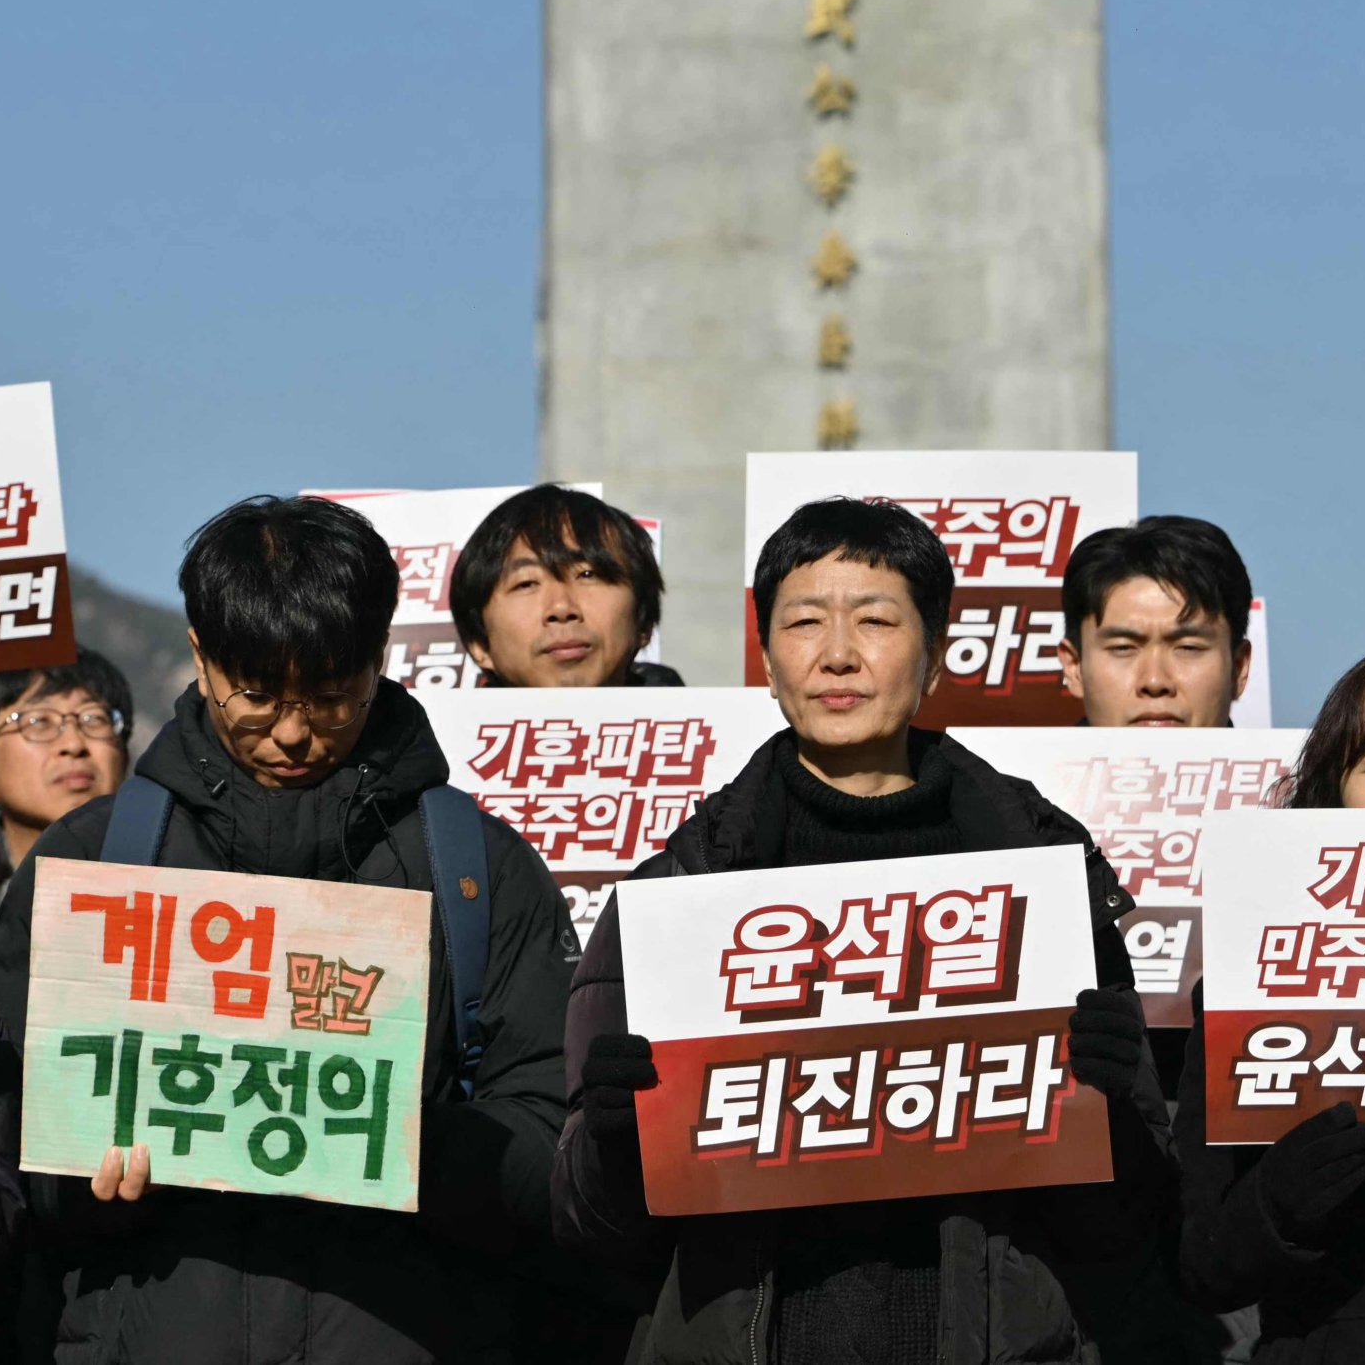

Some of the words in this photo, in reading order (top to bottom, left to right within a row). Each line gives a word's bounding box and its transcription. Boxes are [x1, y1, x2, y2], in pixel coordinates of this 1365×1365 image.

[467, 718, 591, 789] 기후
[590, 718, 717, 786] 파탄
[1056, 756, 1167, 822] 기후
[70, 891, 276, 1019] 계엄
[285, 951, 385, 1036] 말고
[720, 883, 1028, 1025] 윤석열
[60, 1028, 394, 1182] 기후정의
[695, 1034, 1075, 1167] 퇴진하라
